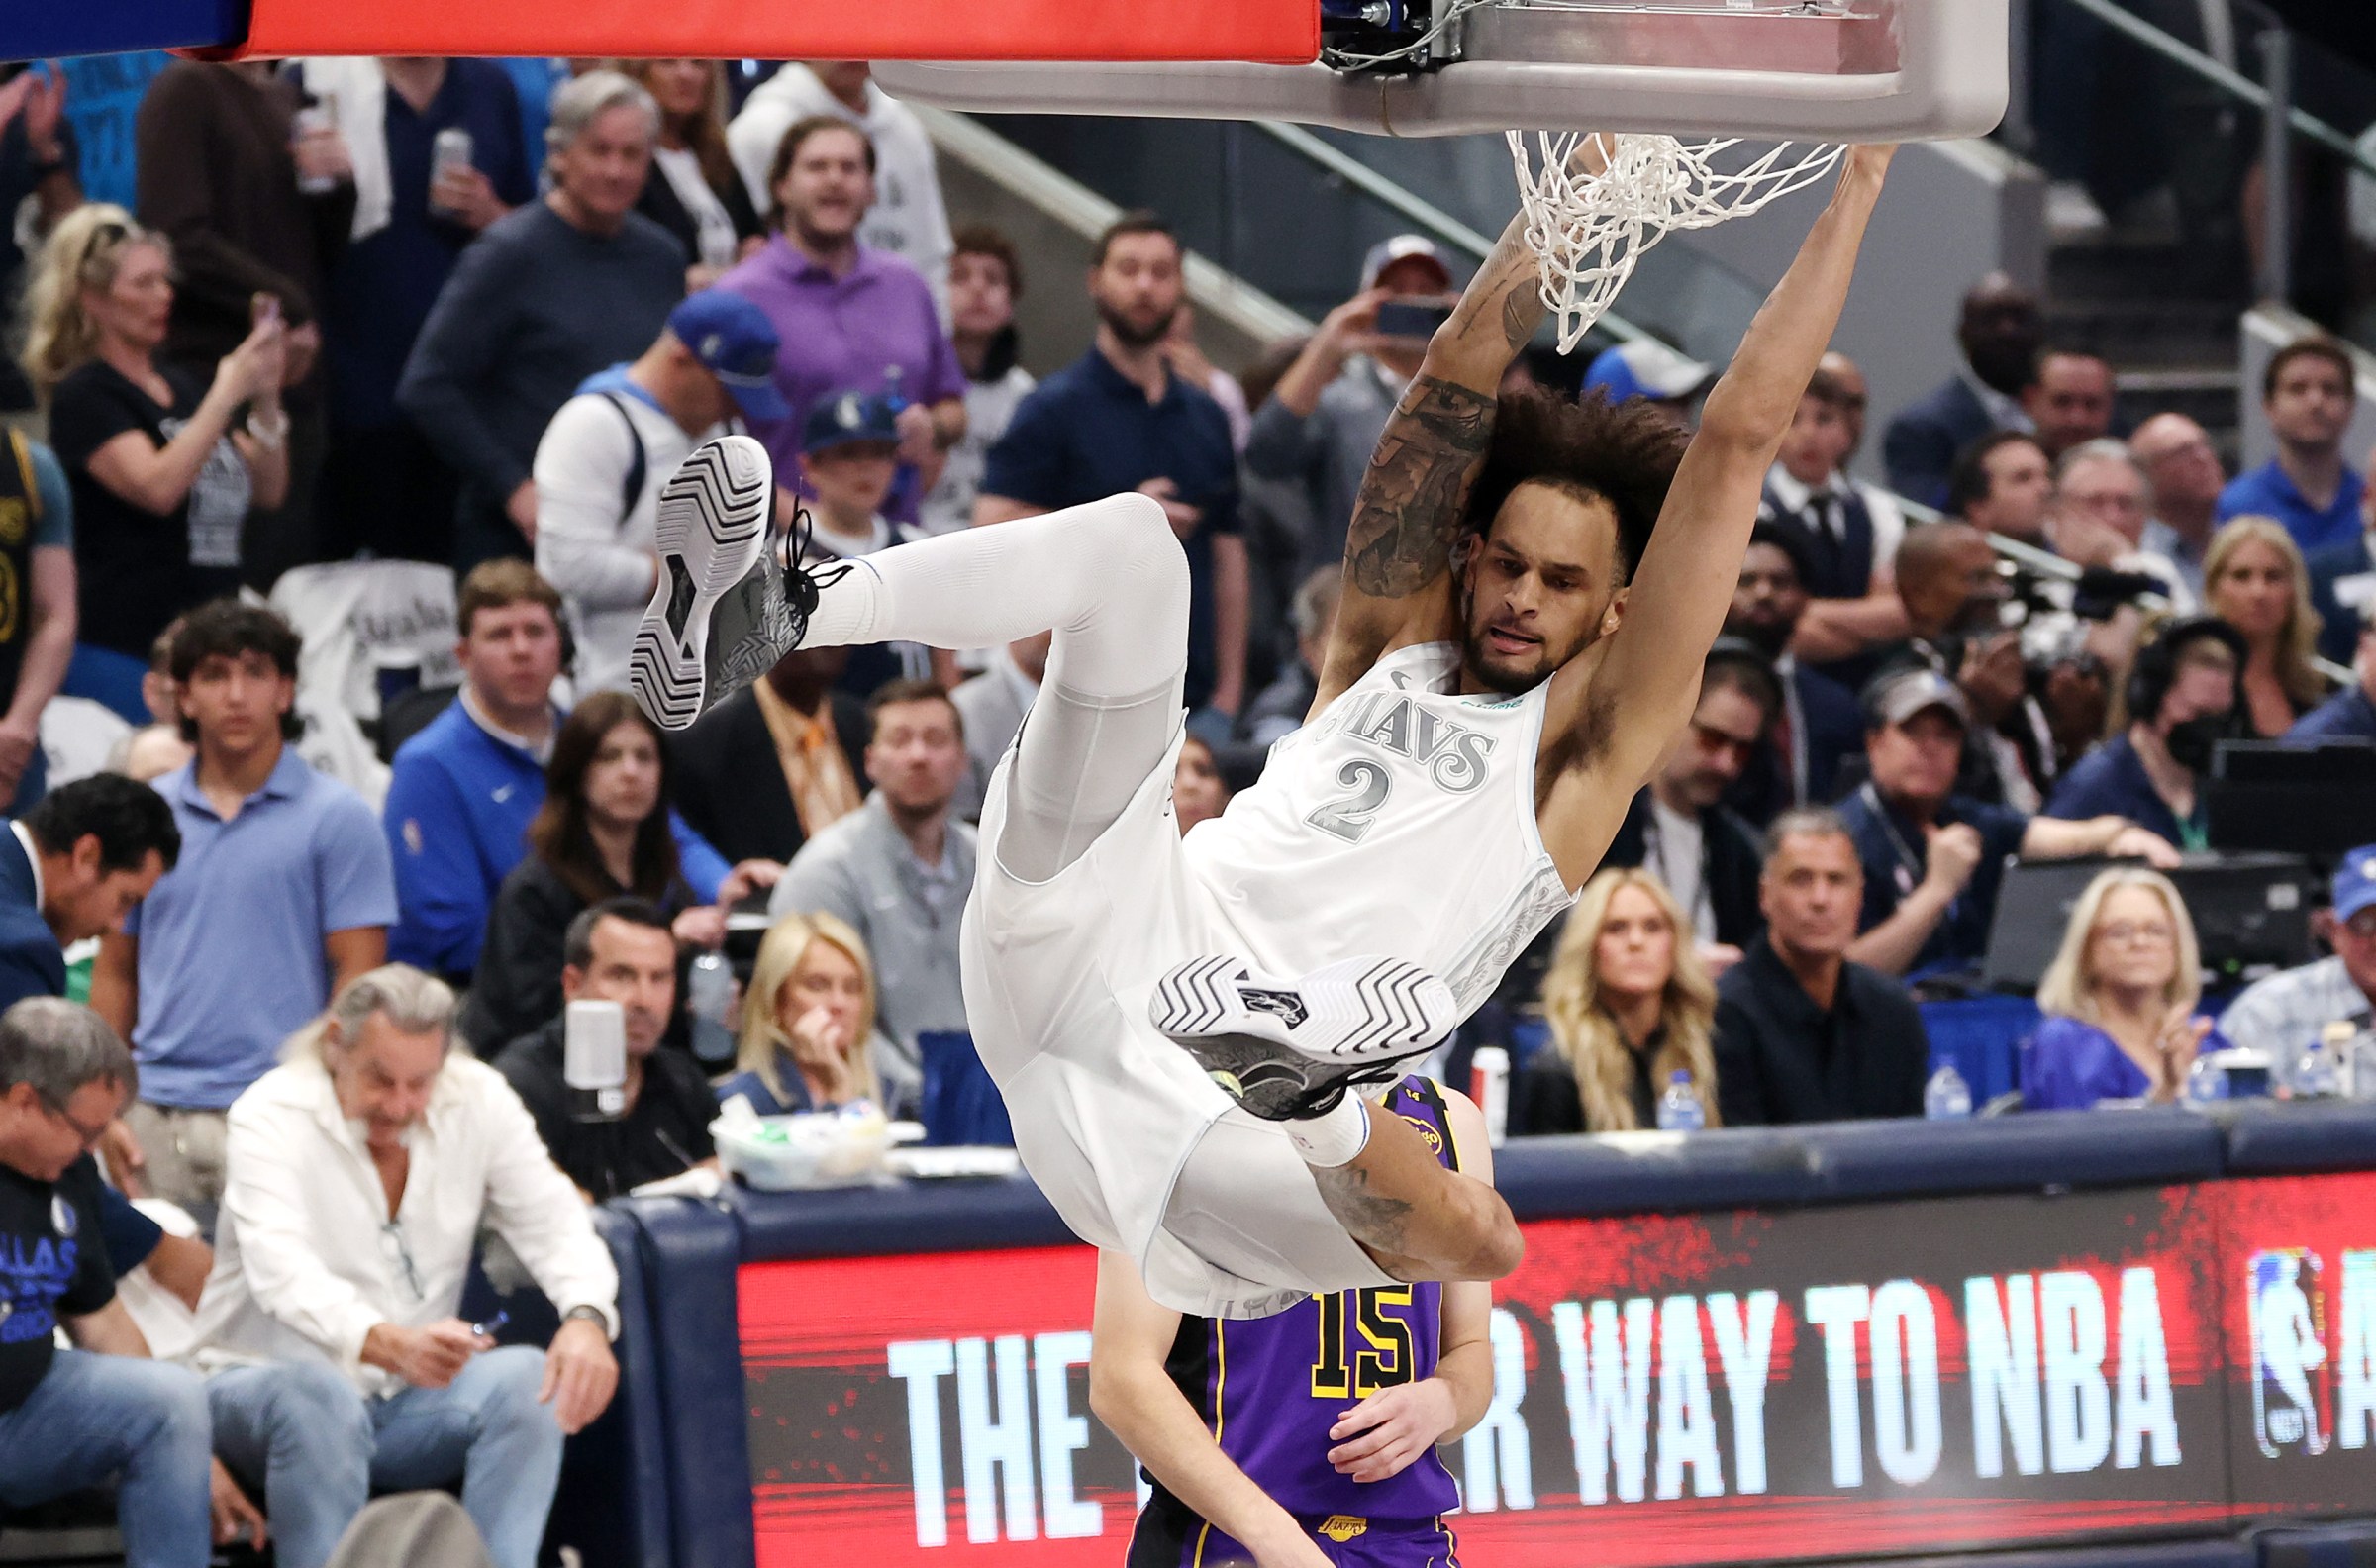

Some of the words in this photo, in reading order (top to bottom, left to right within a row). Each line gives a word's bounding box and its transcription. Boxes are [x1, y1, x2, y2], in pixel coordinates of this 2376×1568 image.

[1314, 689, 1500, 795] MAVS
[1302, 756, 1393, 844] 2
[1310, 1283, 1415, 1399] 15
[886, 1330, 1104, 1547] THE
[1551, 1289, 1780, 1506] WAY
[1804, 1278, 1944, 1489] TO
[1963, 1266, 2183, 1479] NBA
[1323, 1518, 1365, 1535] LAKERS
